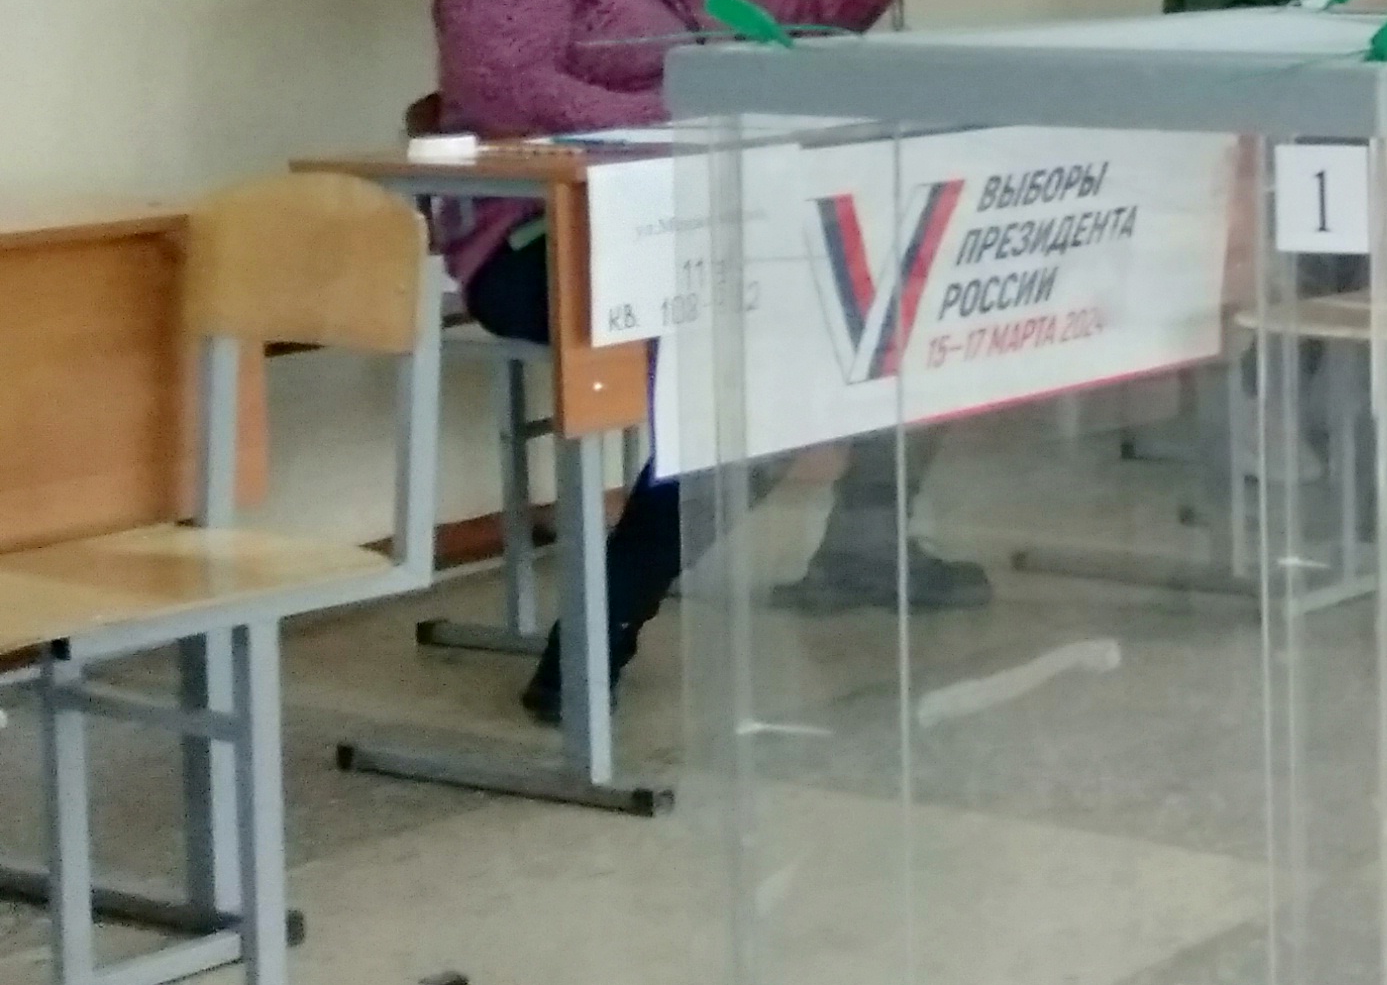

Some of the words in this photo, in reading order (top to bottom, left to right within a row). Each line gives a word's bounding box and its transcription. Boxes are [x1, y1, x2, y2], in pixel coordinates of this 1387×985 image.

[977, 161, 1109, 212] ВЫБОРЫ
[1315, 170, 1331, 232] 1
[956, 205, 1139, 266] ПРЕЗИДЕНТА
[938, 266, 1060, 322] РОССИИ
[988, 314, 1057, 356] МАРТА
